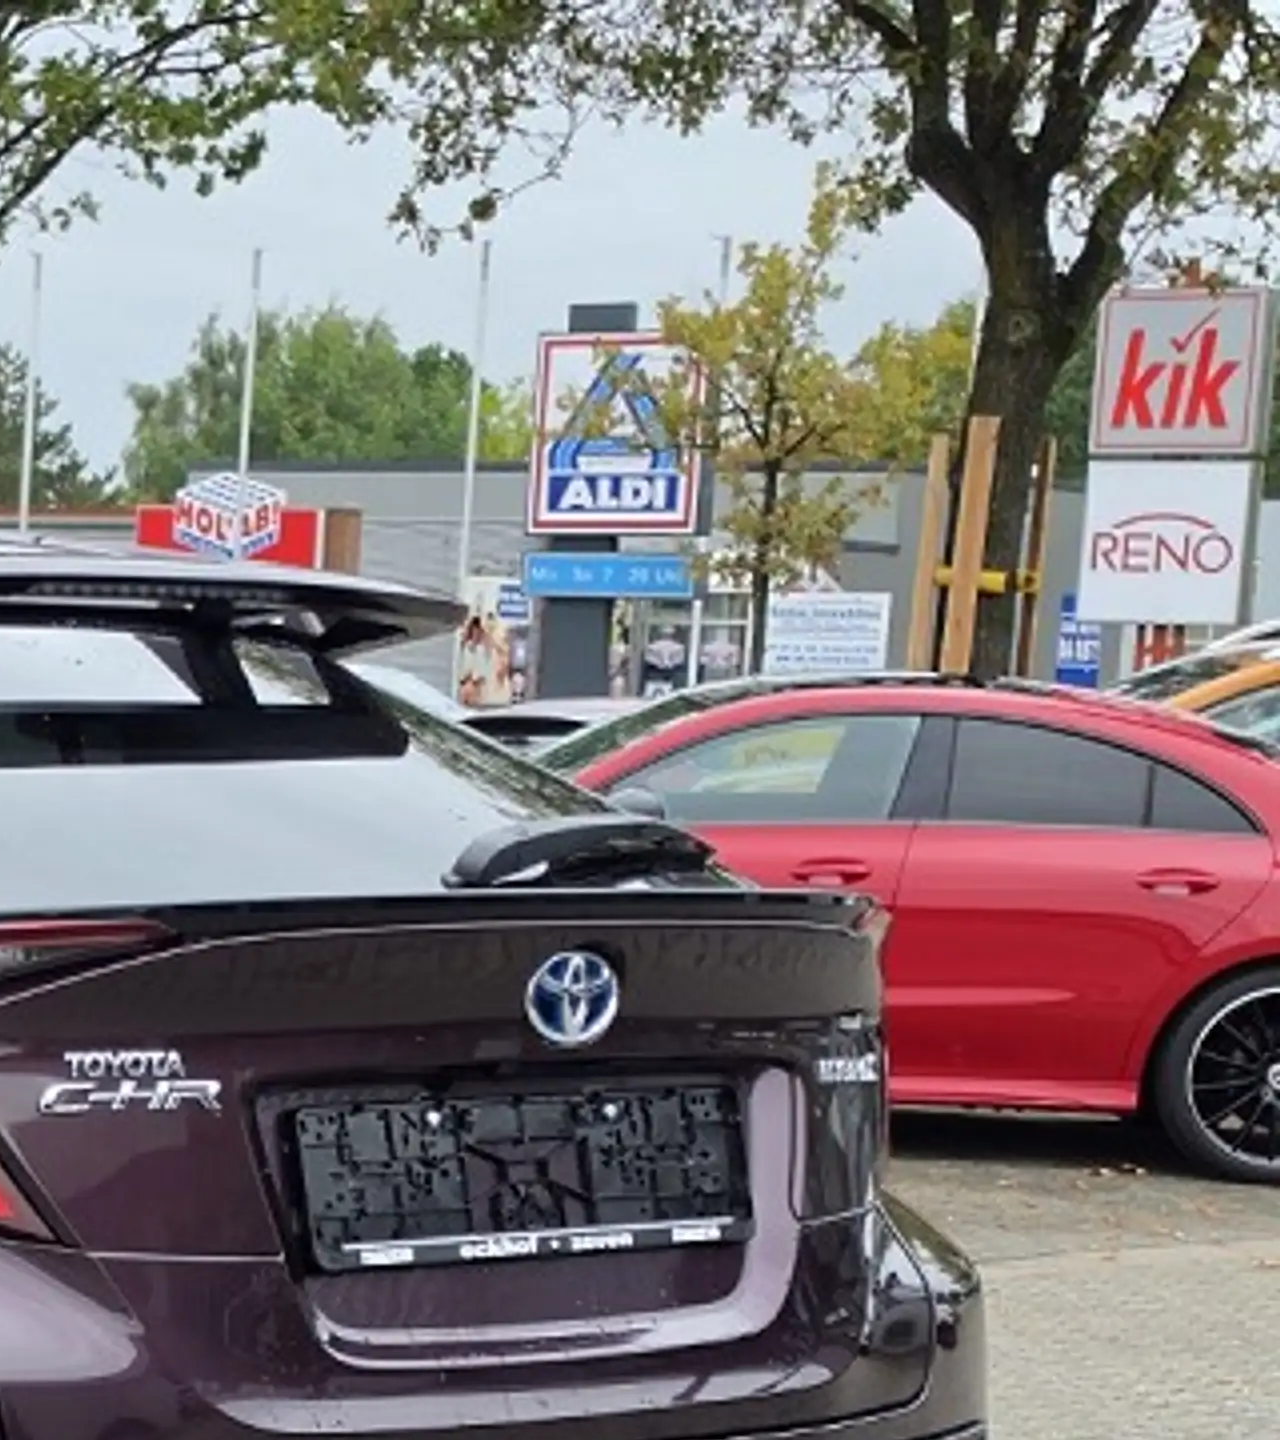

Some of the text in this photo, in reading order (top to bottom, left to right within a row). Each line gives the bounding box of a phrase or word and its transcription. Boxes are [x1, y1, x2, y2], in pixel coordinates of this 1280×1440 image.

[1110, 310, 1241, 429] kik
[557, 475, 668, 510] ALDI
[1090, 531, 1234, 574] RENO
[64, 1050, 186, 1077] TOYOTA
